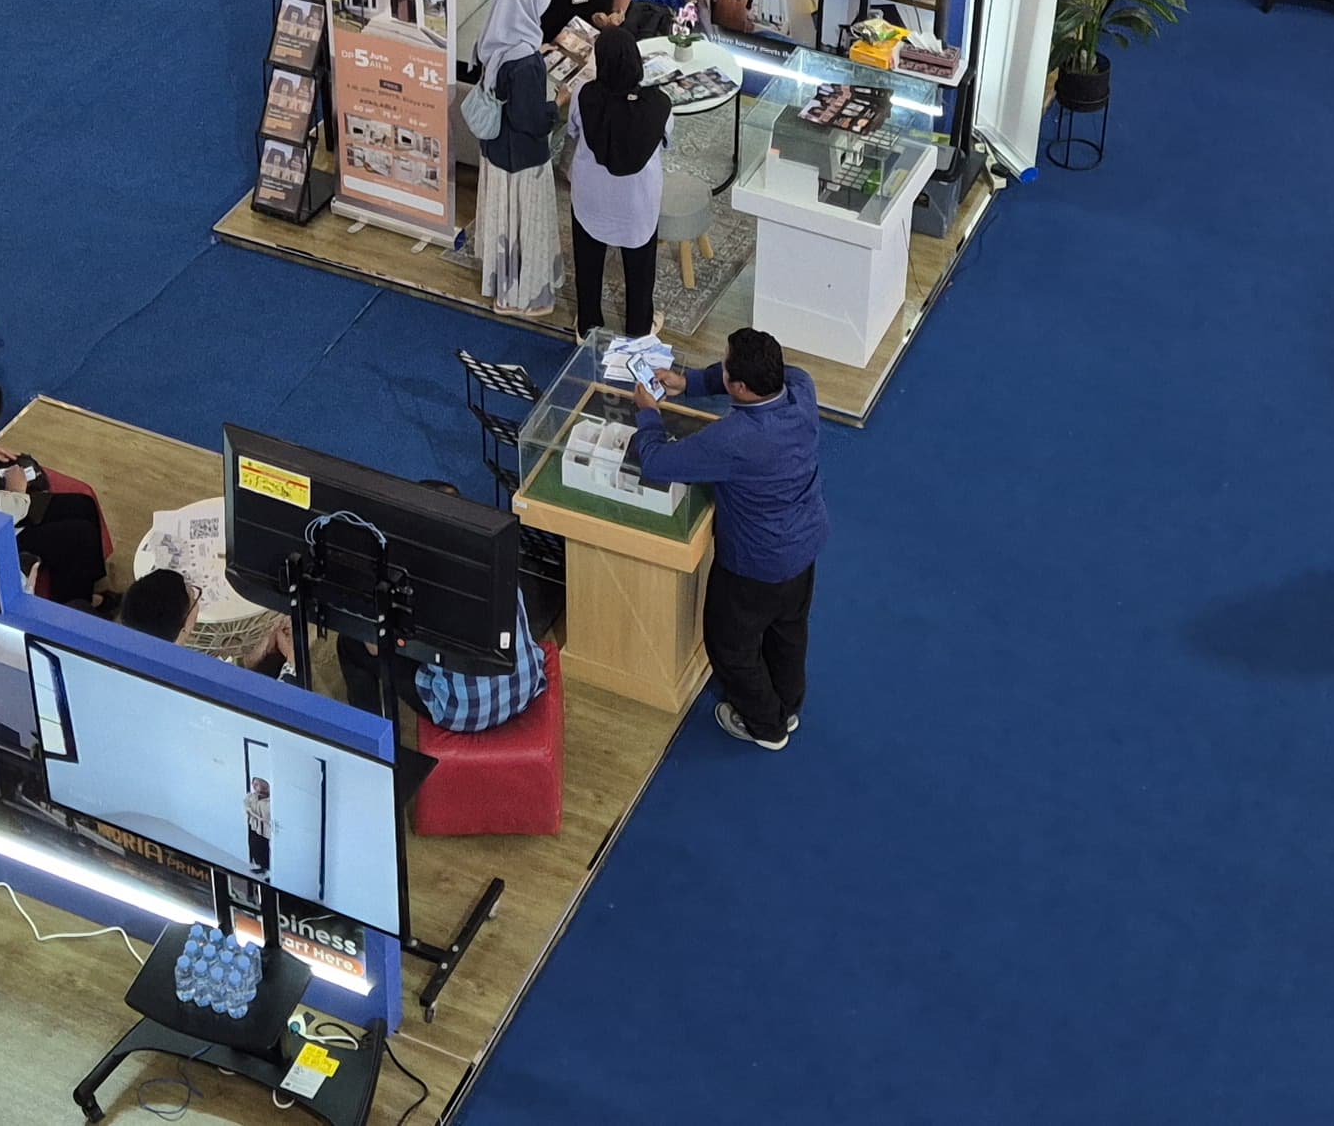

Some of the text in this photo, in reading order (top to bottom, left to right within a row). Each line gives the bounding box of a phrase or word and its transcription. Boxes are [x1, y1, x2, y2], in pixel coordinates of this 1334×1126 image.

[354, 48, 369, 67] 5
[369, 52, 389, 63] Juta
[402, 62, 415, 78] 4
[279, 914, 357, 957] piness
[312, 945, 359, 975] Here.
